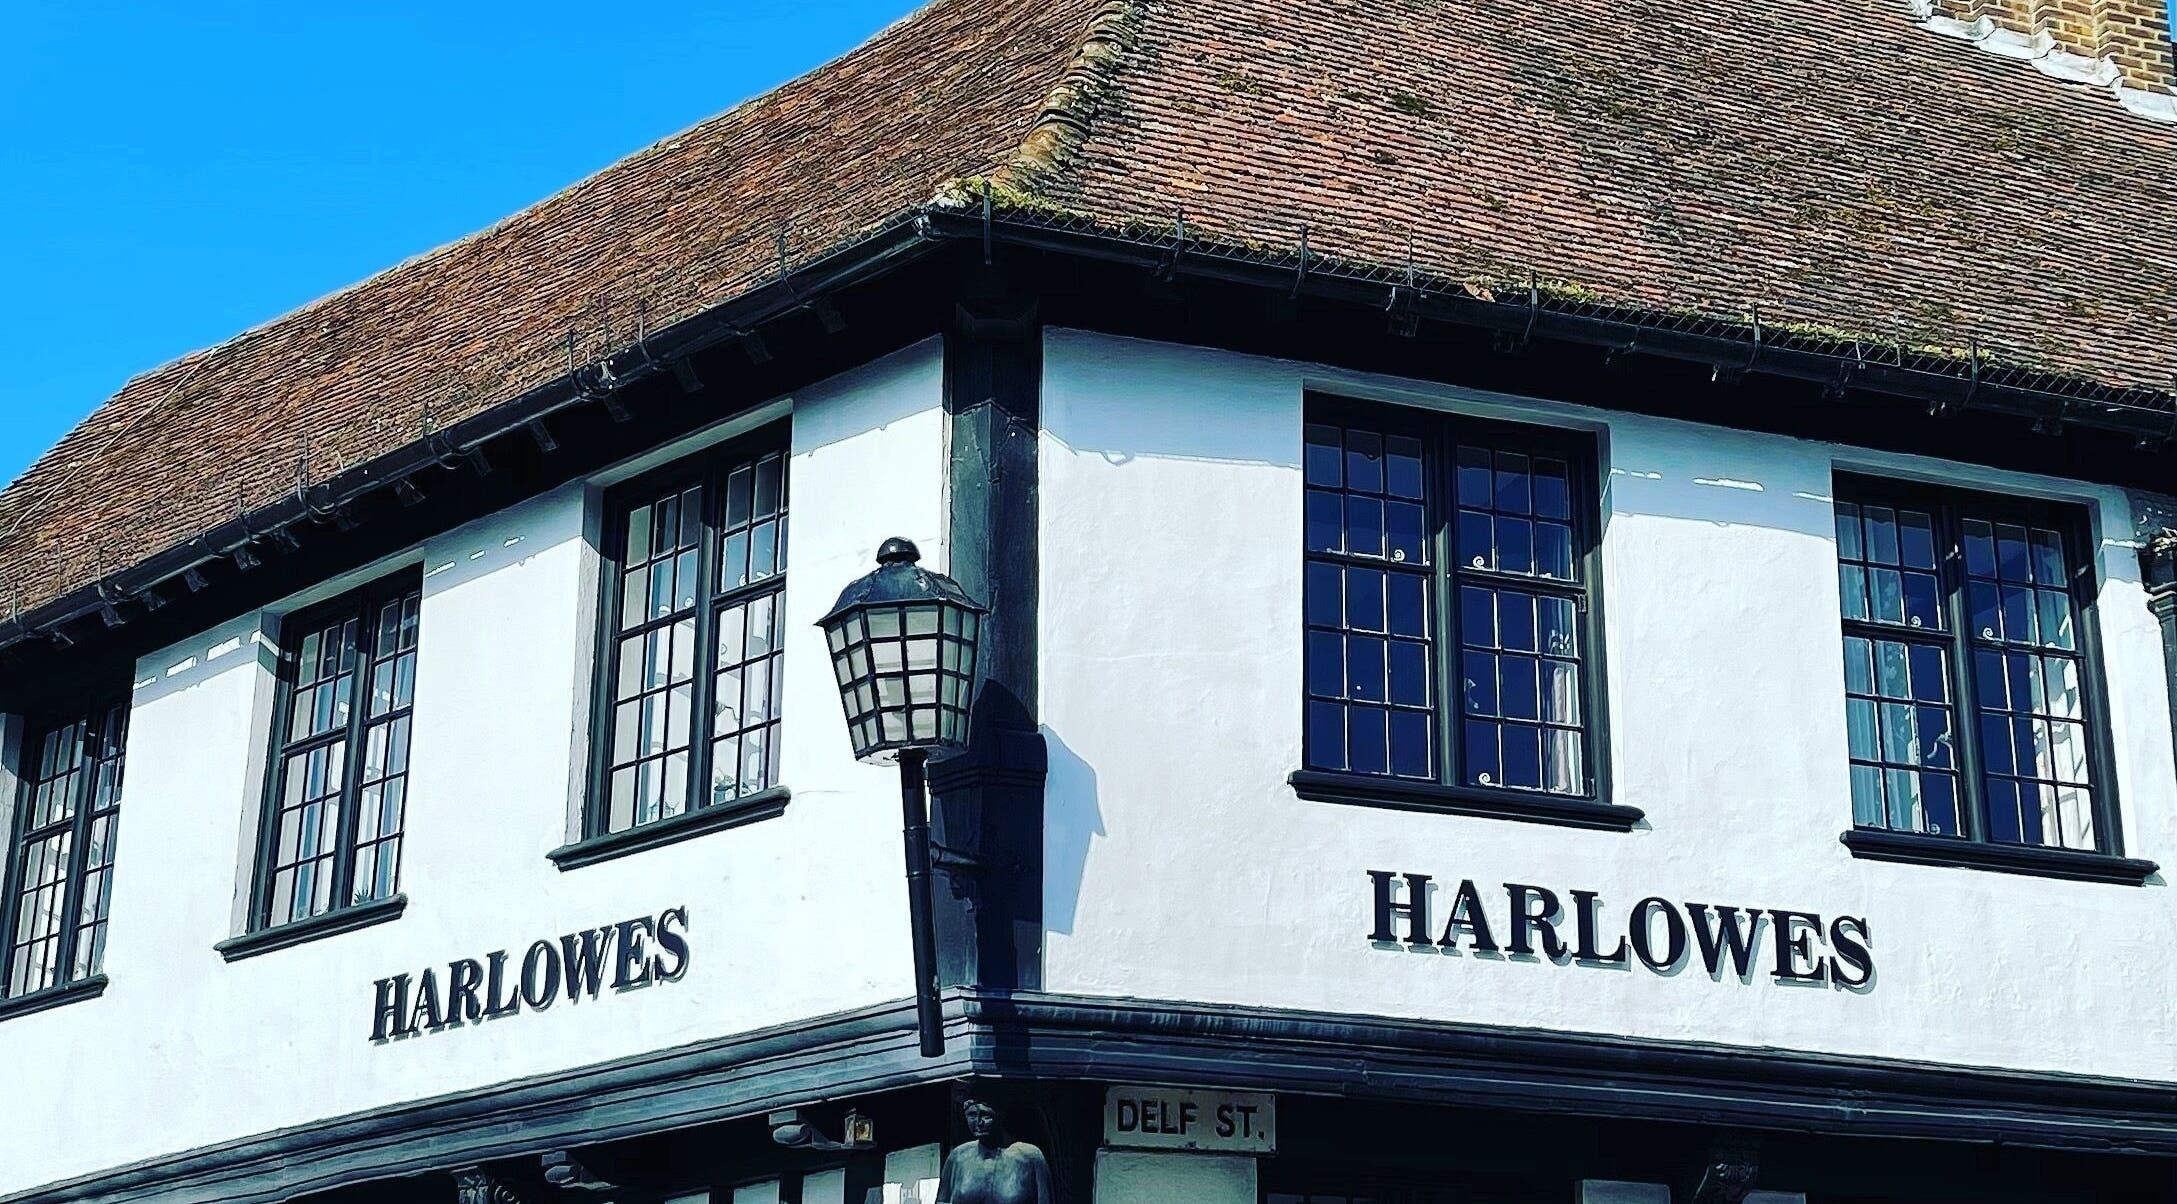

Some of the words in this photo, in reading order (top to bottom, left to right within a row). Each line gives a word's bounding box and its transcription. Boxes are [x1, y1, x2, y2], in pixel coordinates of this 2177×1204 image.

[369, 905, 690, 1044] HARLOWES
[1366, 869, 1874, 989] HARLOWES
[1117, 1099, 1198, 1135] DELF
[1215, 1104, 1265, 1140] ST.
